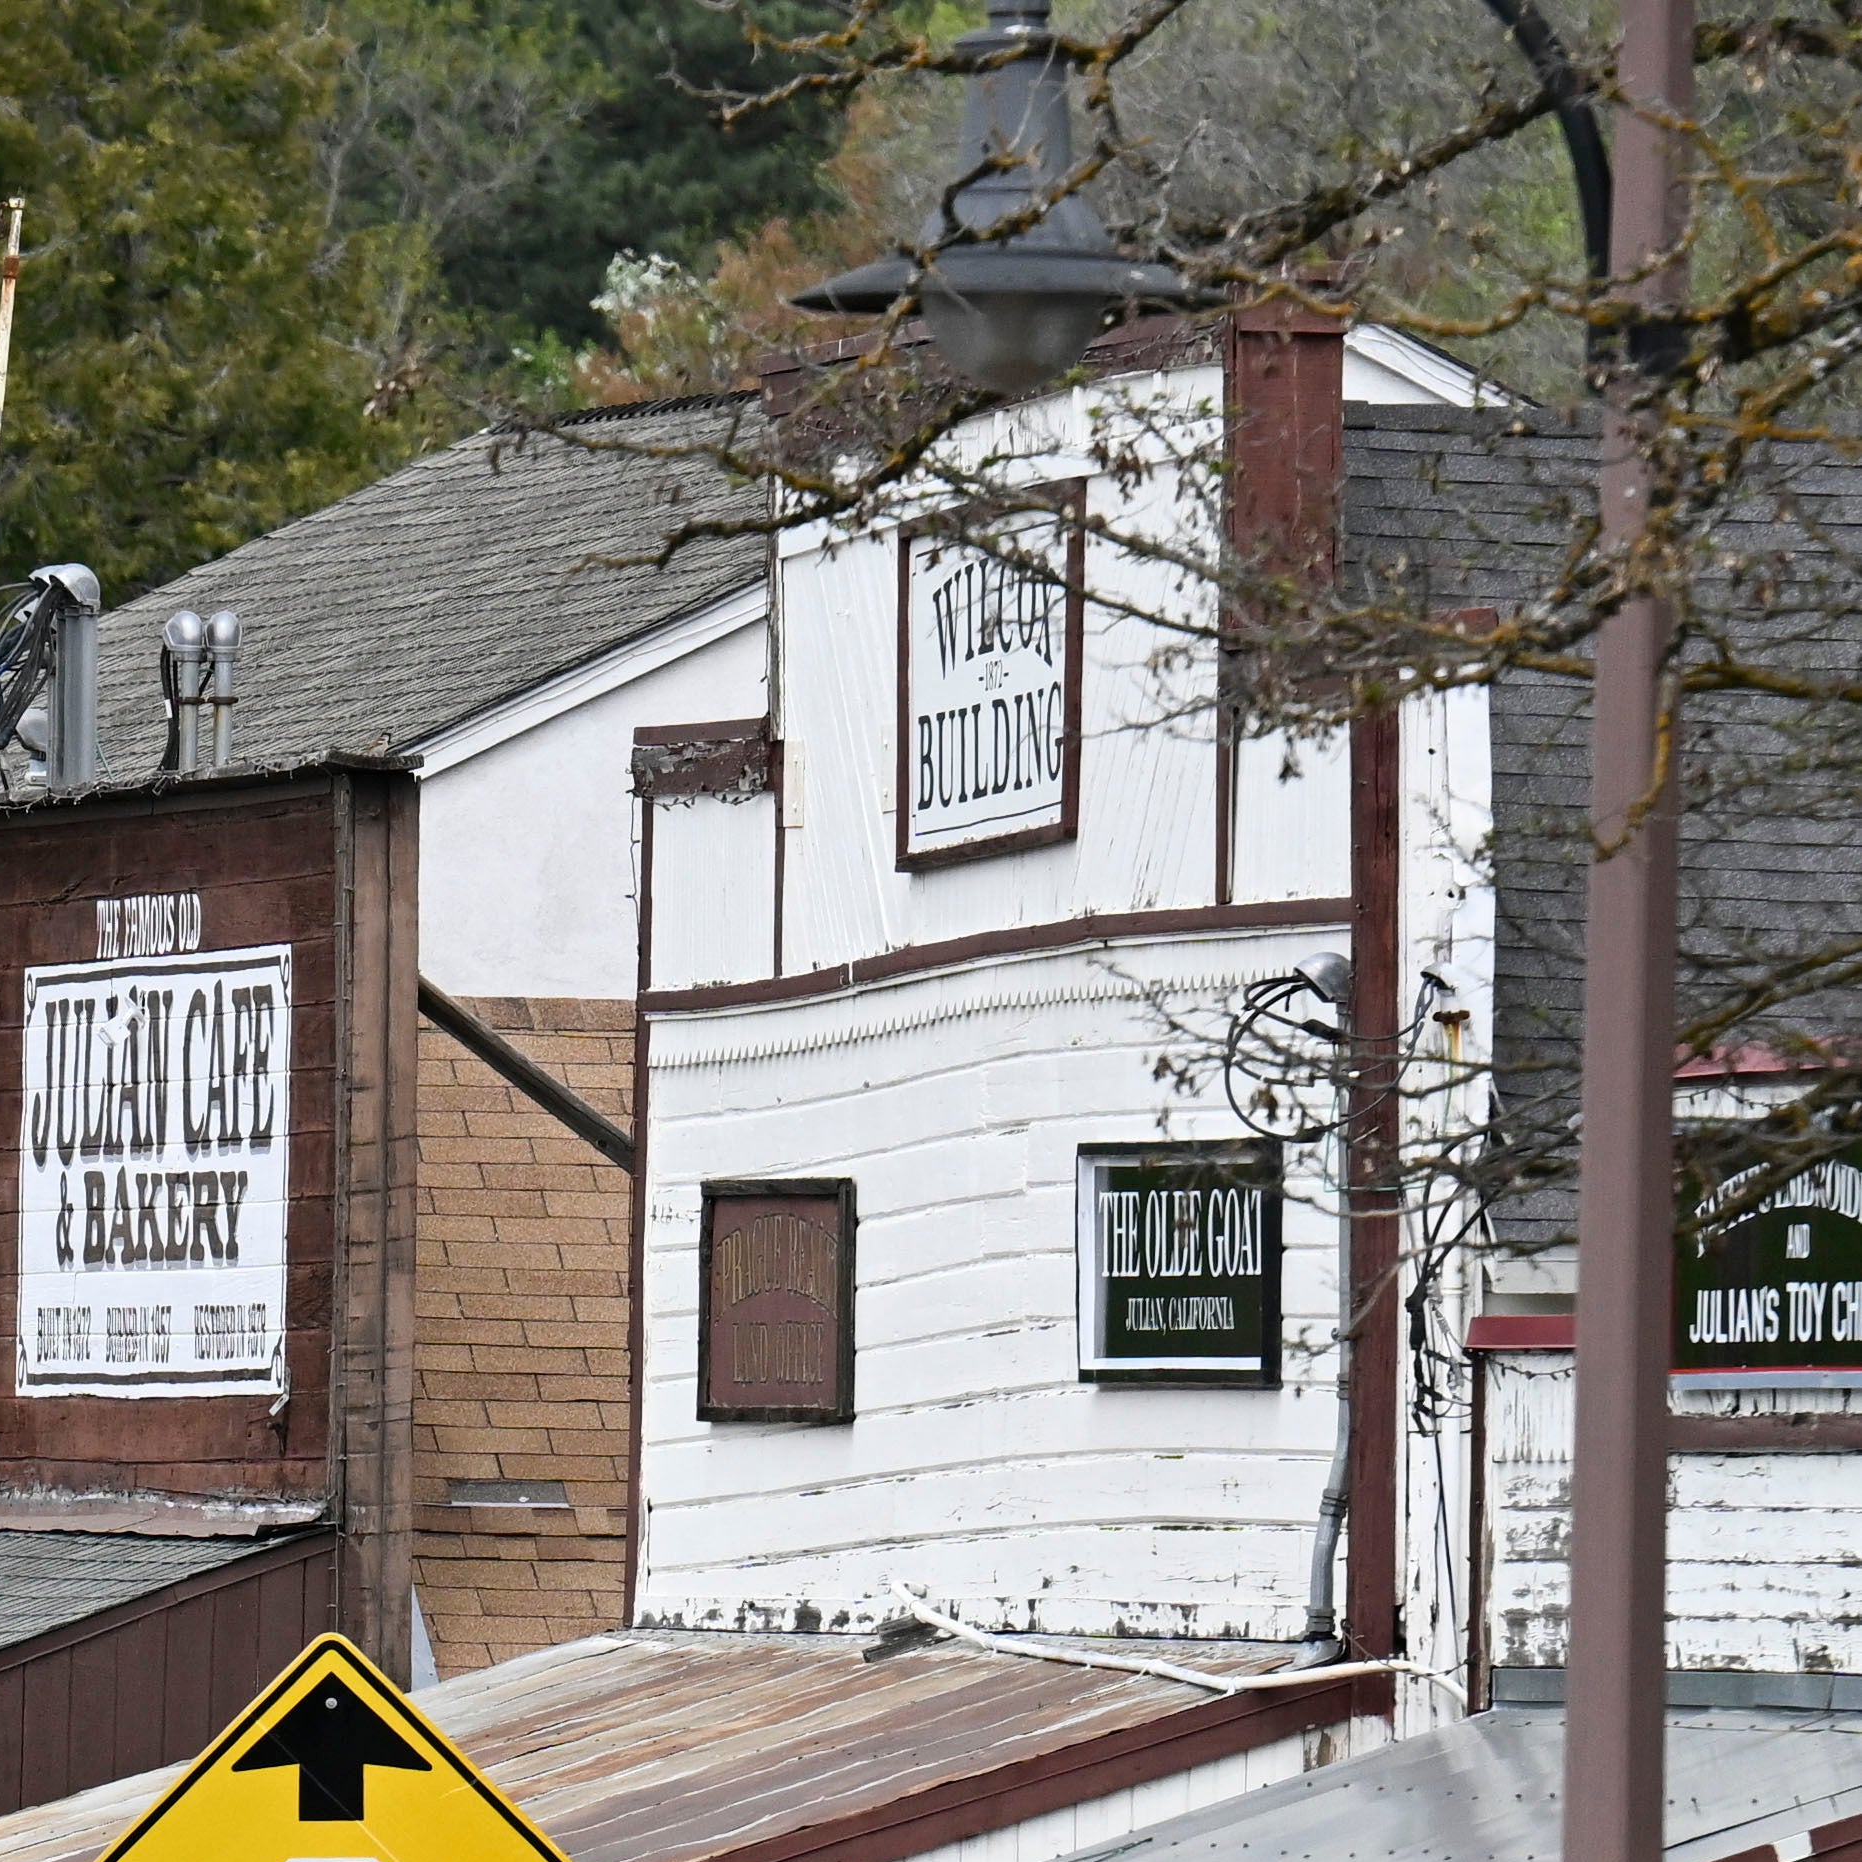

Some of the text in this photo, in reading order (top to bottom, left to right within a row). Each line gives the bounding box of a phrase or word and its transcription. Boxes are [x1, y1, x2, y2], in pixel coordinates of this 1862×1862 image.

[932, 556, 1054, 680] WILCOX
[917, 681, 1063, 812] BUILDING
[97, 894, 201, 959] THE FAMOUS OLD
[31, 978, 275, 1168] JULIAN CAFE
[55, 1164, 250, 1268] & BAKERY
[1098, 1187, 1263, 1279] THE OLDE GOAT
[1786, 1223, 1811, 1259] AND
[1125, 1296, 1235, 1337] JULIAN, CALIFORNIA
[1688, 1285, 1780, 1345] JULIAN'S
[1785, 1282, 1828, 1343] TOY
